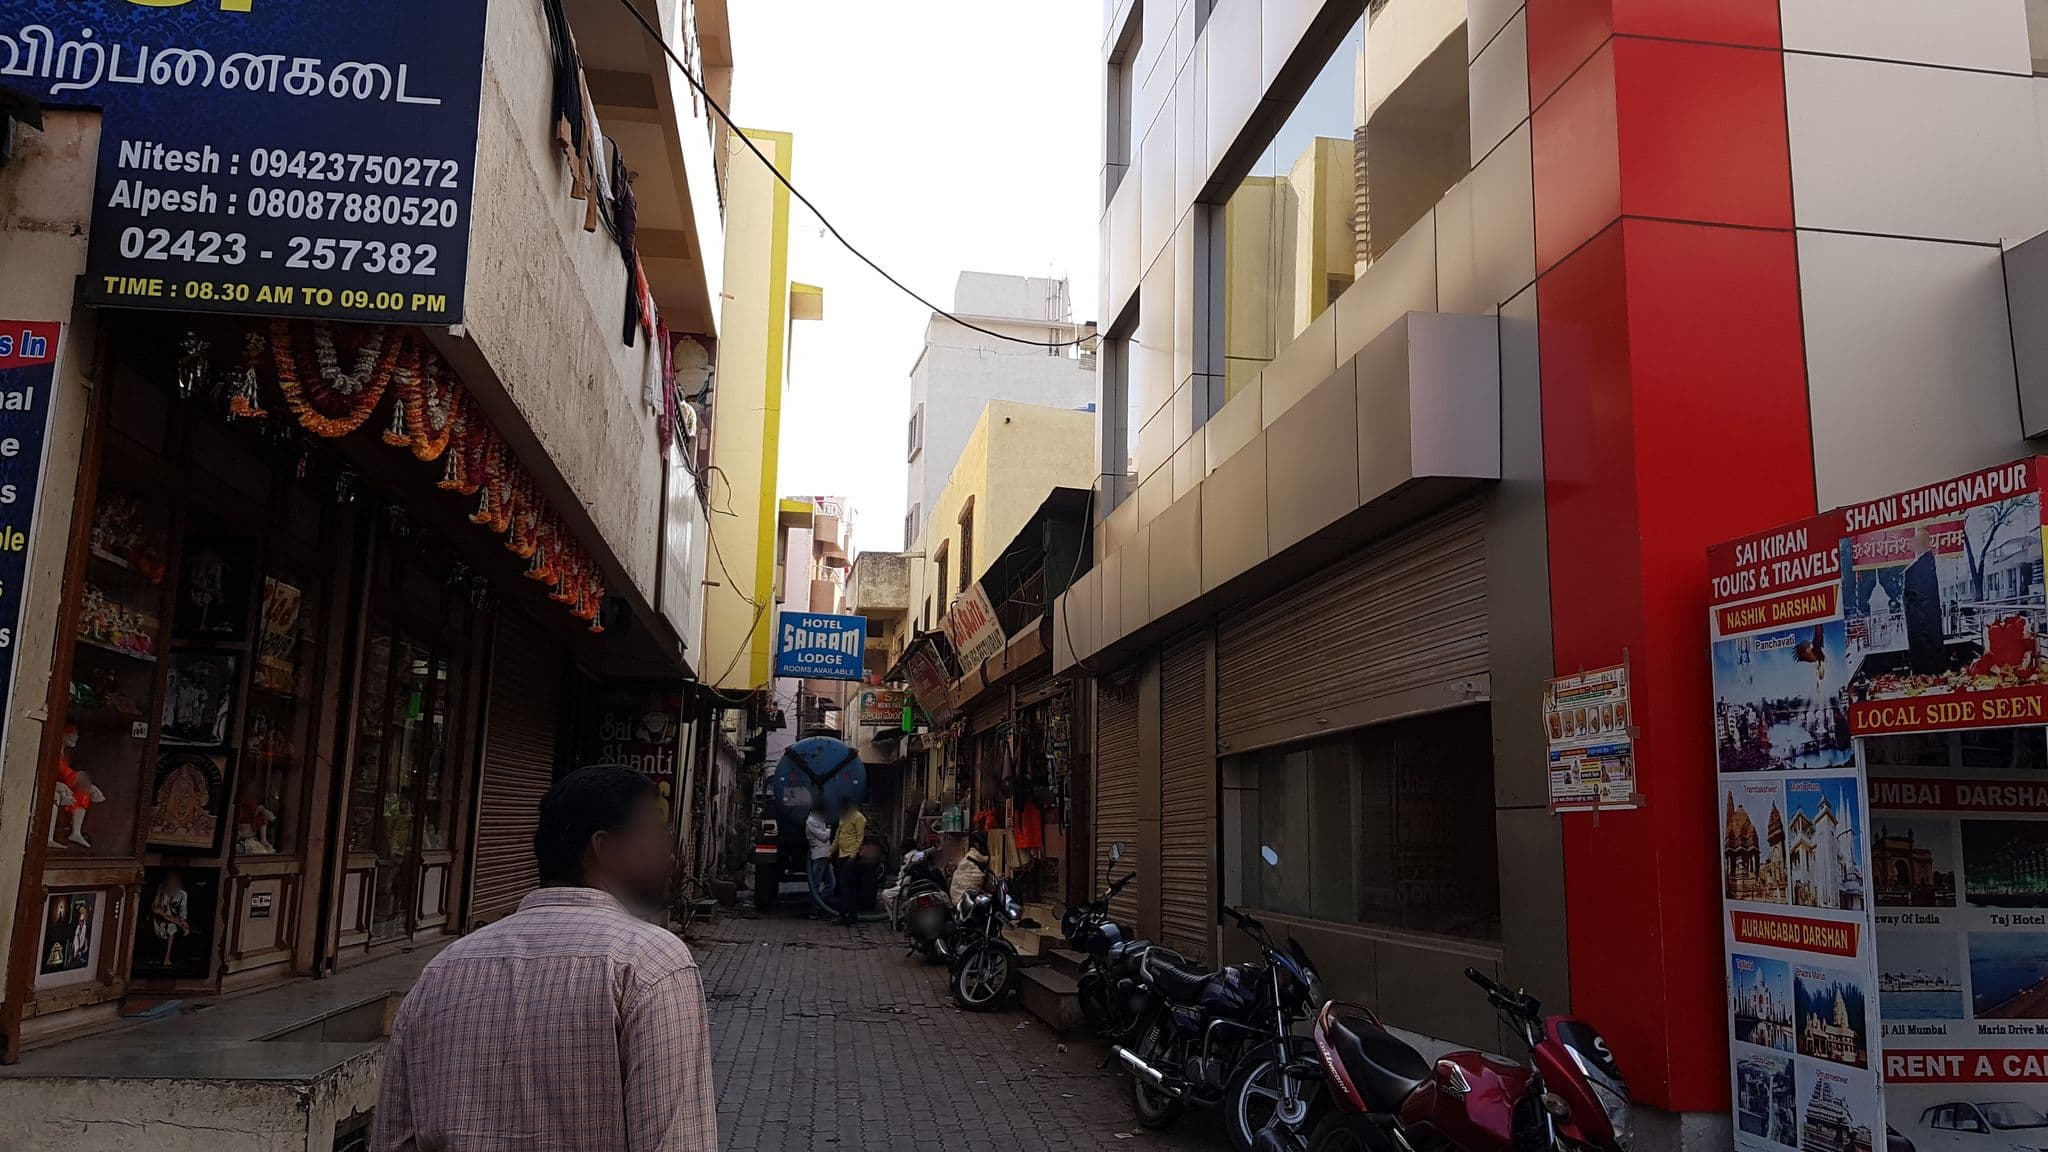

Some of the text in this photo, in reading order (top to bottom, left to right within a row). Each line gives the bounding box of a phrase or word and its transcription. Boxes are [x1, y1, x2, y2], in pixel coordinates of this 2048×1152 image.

[118, 139, 220, 174] Nitesh
[249, 147, 459, 188] 09423750272
[108, 180, 217, 217] Alpesh
[247, 187, 458, 228] 08087880520
[119, 226, 247, 265] 02423
[286, 235, 438, 276] 257382
[104, 275, 164, 297] TIME
[185, 280, 250, 302] 08.30
[256, 285, 293, 304] AM
[302, 286, 334, 306] TO
[340, 289, 404, 310] 09.00
[411, 292, 446, 312] PM
[1845, 463, 2027, 533] SHANI SHINGNAPUR
[1735, 527, 1808, 567] SAI KIRAN
[1712, 547, 1840, 599] TOURS & TRAVELS
[802, 618, 843, 630] HOTEL
[1726, 593, 1827, 630] NASHIK DARSHAN
[783, 623, 860, 658] SAIRAM
[1755, 632, 1796, 652] Panchavati
[783, 664, 855, 676] ROOMS AVAILABLE
[797, 652, 843, 665] LODGE
[600, 712, 632, 740] Sai
[1856, 694, 2042, 730] LOCAL SIDE SEEN
[599, 743, 673, 774] Shanti
[1741, 918, 1849, 950] AURANGABAD DARSHAN
[1902, 914, 1913, 924] Of
[1914, 914, 1941, 924] India
[1990, 915, 2045, 927] Taj Hotel
[1892, 1024, 1905, 1035] Ali
[1907, 1024, 1947, 1035] Mumbai
[1978, 1024, 2006, 1035] Marin
[2007, 1024, 2034, 1035] Drive
[1887, 1054, 1965, 1077] RENT
[1974, 1055, 1995, 1077] A
